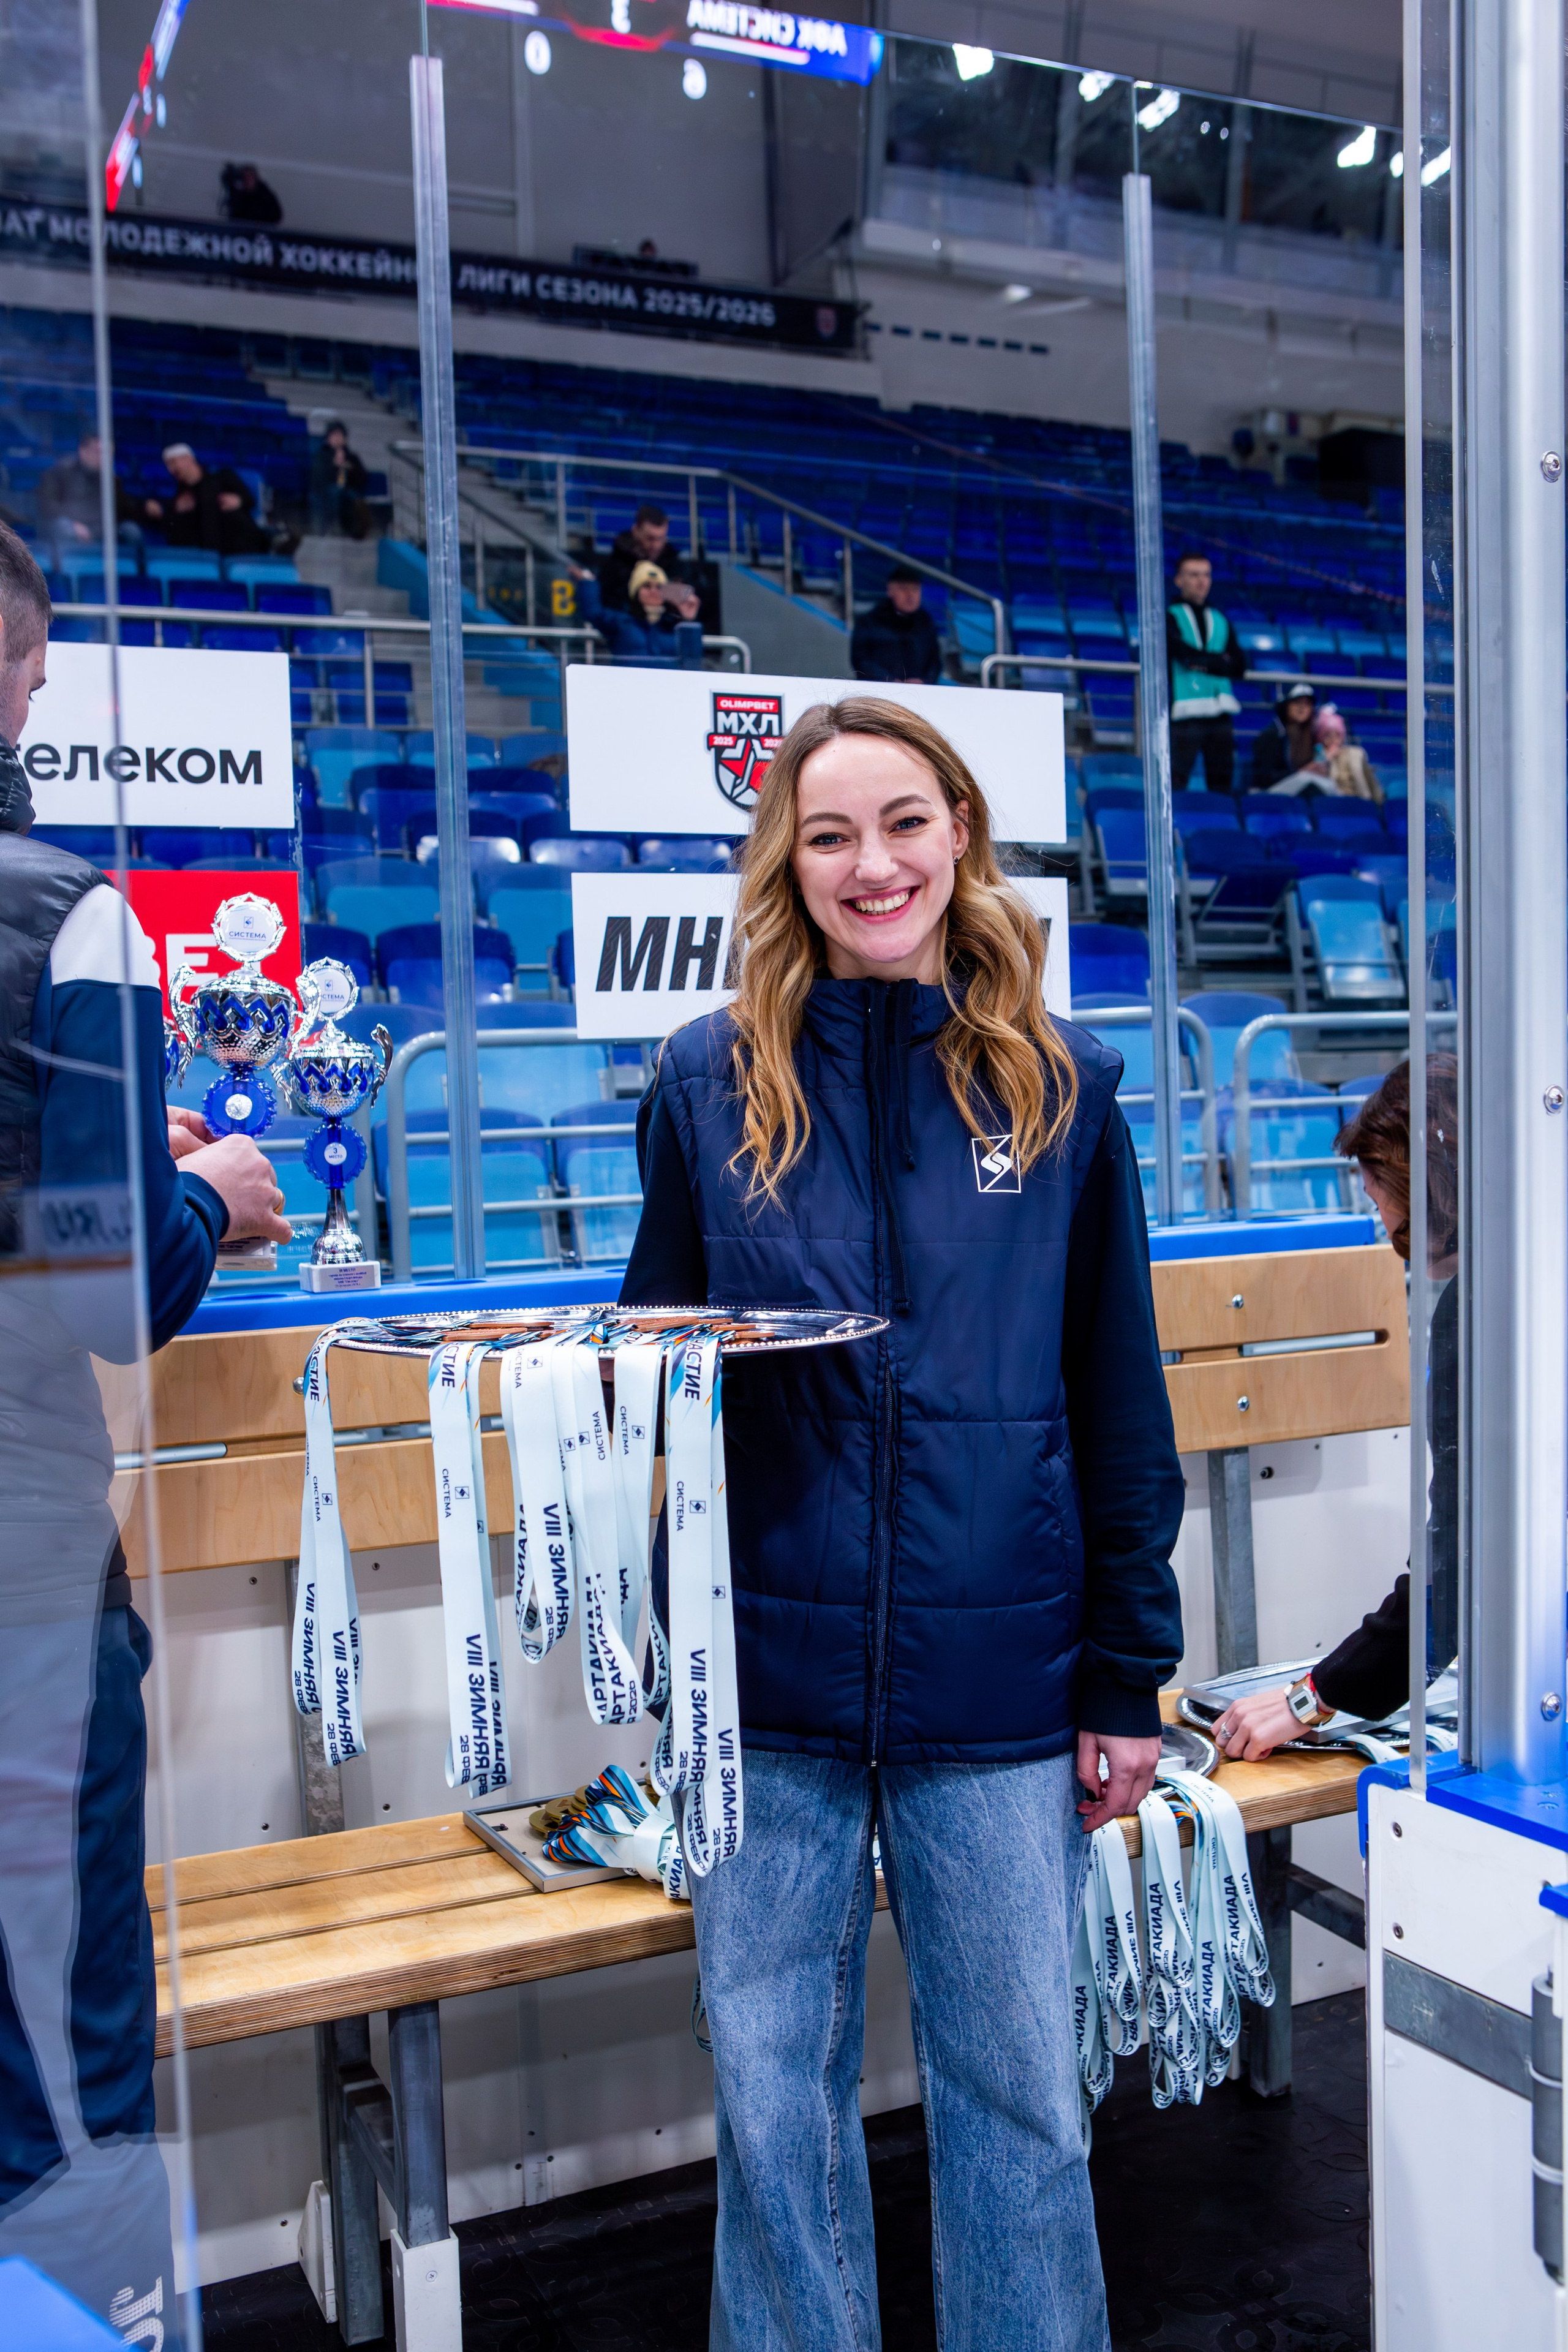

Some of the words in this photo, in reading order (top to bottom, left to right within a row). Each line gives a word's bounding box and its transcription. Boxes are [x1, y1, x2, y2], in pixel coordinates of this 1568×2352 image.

[0, 207, 45, 241] АТ
[279, 241, 419, 284] ХОККЕЙН
[458, 262, 531, 298] ЛИГИ
[535, 273, 639, 311] СЕЗОНА
[643, 288, 777, 328] 2025/2026
[720, 699, 775, 710] OLIMPBET
[717, 711, 780, 736] МХЛ
[712, 736, 734, 746] 2025
[15, 743, 262, 785] елеком
[228, 930, 266, 939] СИСТЕМА
[592, 1411, 606, 1460] СИСТЕМА
[620, 1406, 630, 1455] СИСТЕМА
[442, 1468, 452, 1518] СИСТЕМА
[676, 1480, 685, 1531] СИСТЕМА
[544, 1503, 562, 1537] VIII
[306, 1583, 315, 1613] VIII
[548, 1543, 569, 1641] ЗИМНЯЯ
[545, 1606, 554, 1626] 28
[303, 1617, 320, 1704] ЗИМНЯЯ
[333, 1630, 347, 1661] VIII
[466, 1634, 483, 1667] VIII
[294, 1670, 302, 1686] 28
[690, 1648, 706, 1683] VIII
[336, 1666, 357, 1754] ЗИМНЯЯ
[468, 1673, 490, 1770] ЗИМНЯЯ
[327, 1722, 336, 1740] 28
[459, 1735, 470, 1753] 28
[689, 1689, 707, 1784] ЗИМНЯЯ
[718, 1728, 734, 1761] VIII
[655, 1755, 670, 1792] ФЕВР
[679, 1751, 688, 1769] 28
[687, 1813, 693, 1832] 28
[720, 1767, 737, 1858] ЗИМНЯЯ
[713, 1828, 721, 1845] 28
[1174, 1880, 1183, 1904] VIII
[1241, 1872, 1251, 1895] VIII
[1125, 1910, 1134, 1934] VIII
